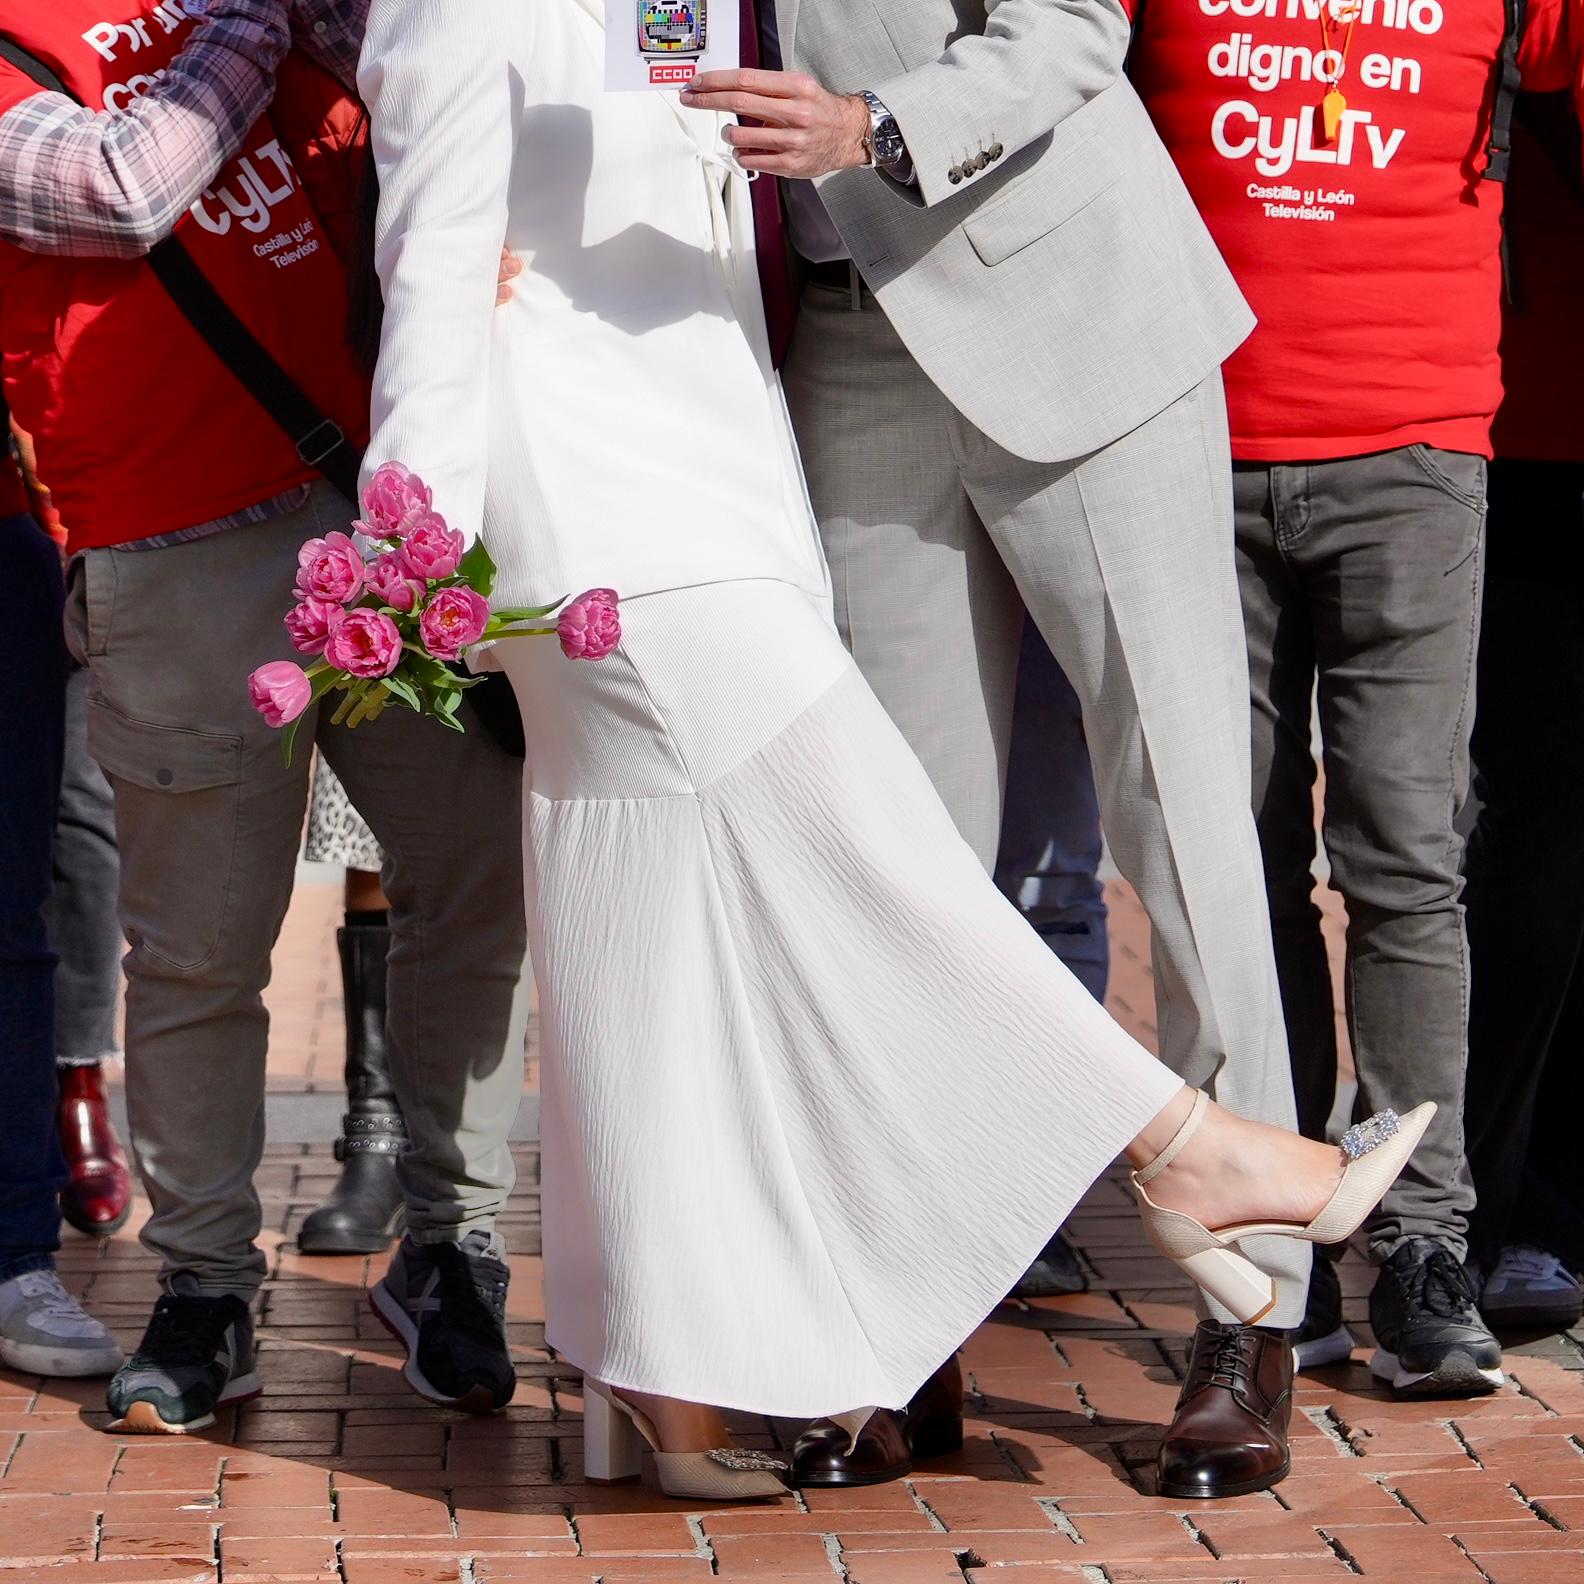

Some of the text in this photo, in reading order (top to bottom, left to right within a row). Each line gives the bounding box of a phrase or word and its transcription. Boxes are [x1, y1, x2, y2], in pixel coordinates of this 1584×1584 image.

[652, 68, 693, 80] CCOO
[1207, 32, 1422, 94] digno en
[1211, 99, 1406, 178] CyLTv
[189, 138, 302, 236] CyLT
[1246, 183, 1355, 206] Castilla y León
[1262, 202, 1335, 222] Televisión
[292, 228, 302, 244] y
